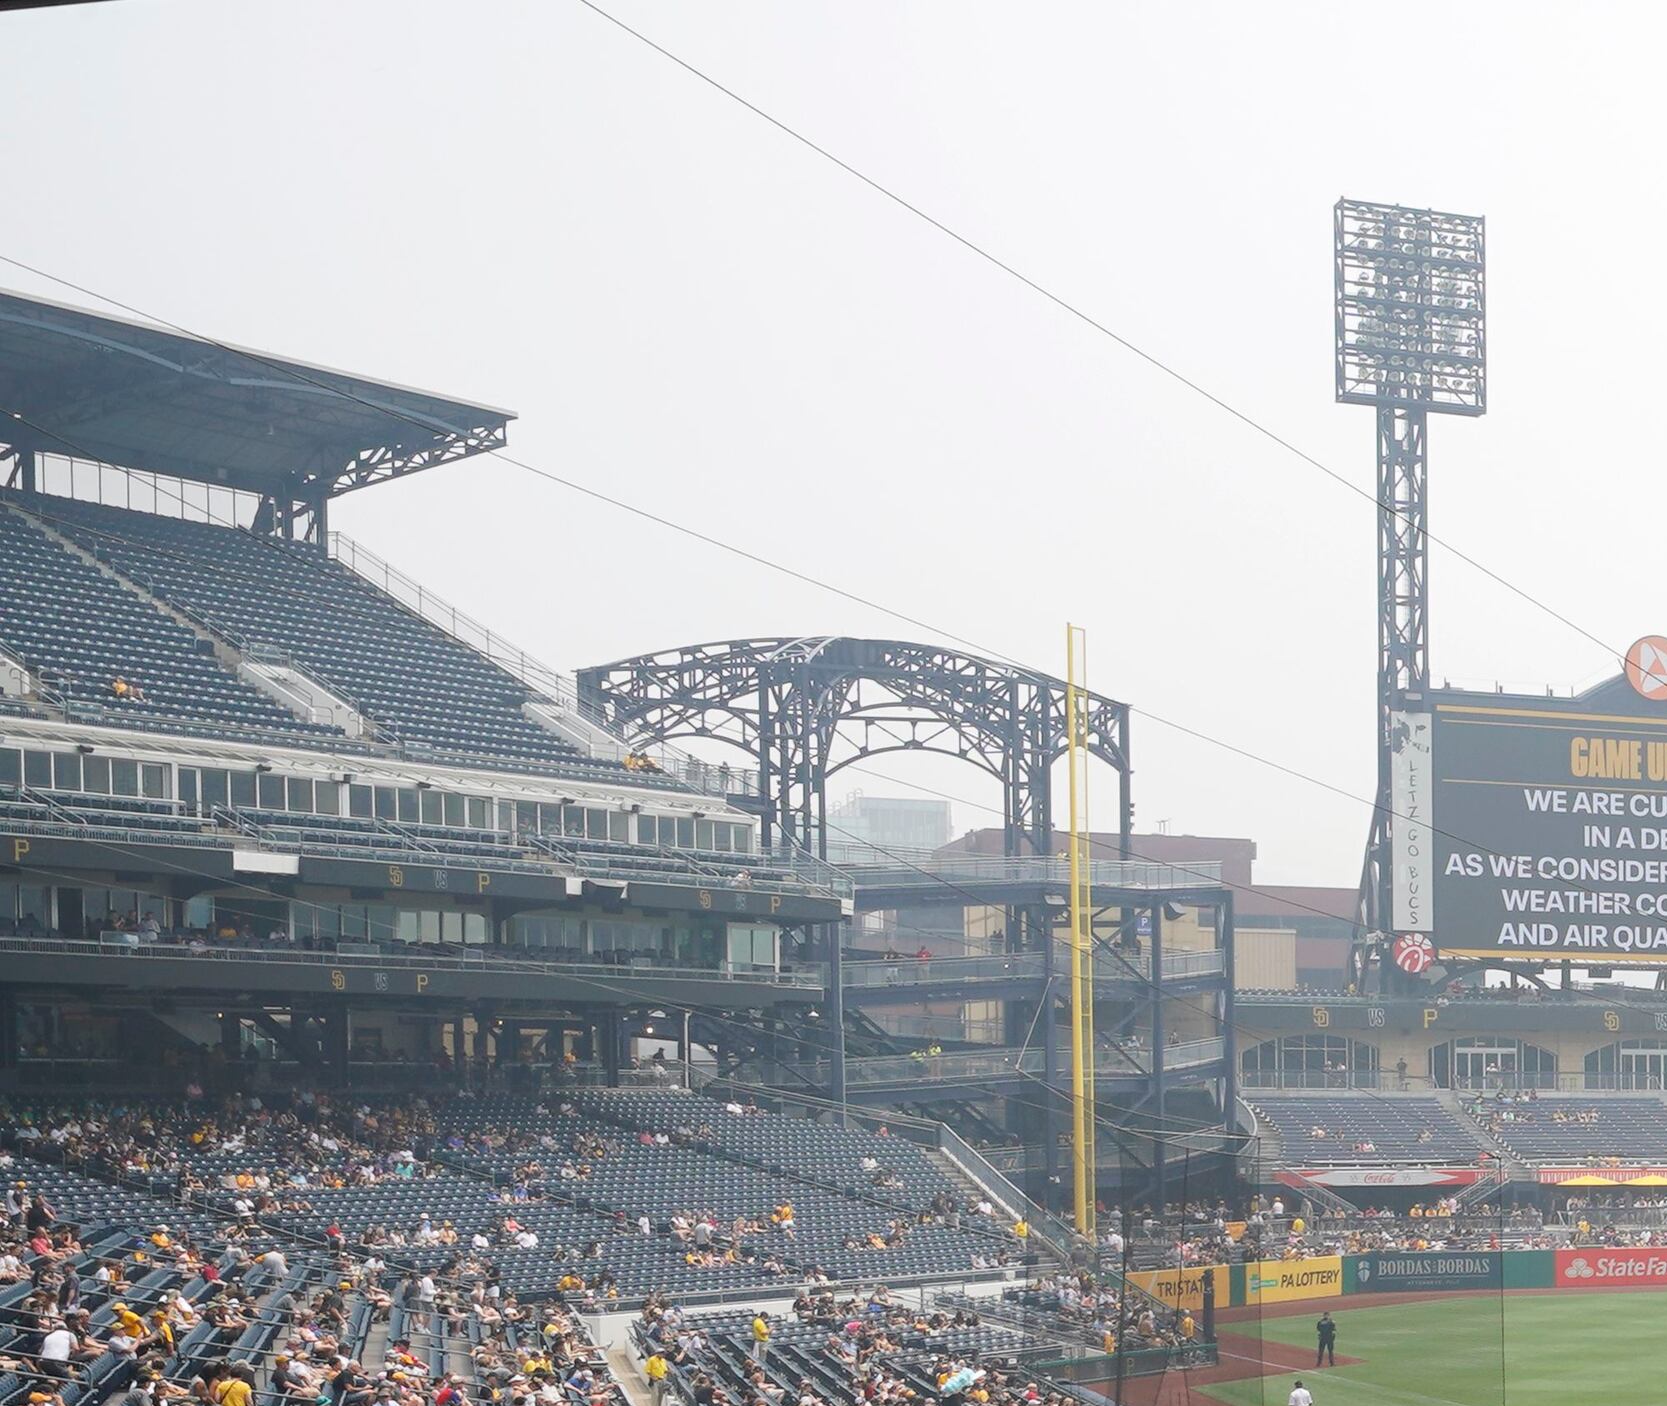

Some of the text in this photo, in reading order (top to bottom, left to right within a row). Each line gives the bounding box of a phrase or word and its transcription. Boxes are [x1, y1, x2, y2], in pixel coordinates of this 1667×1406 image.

[1570, 736, 1642, 780] GAME
[1524, 789, 1566, 814] WE
[1572, 792, 1624, 816] ARE
[1584, 826, 1611, 848] IN
[1615, 827, 1636, 849] A
[1444, 853, 1483, 877] AS
[1489, 855, 1532, 878] WE
[1502, 888, 1631, 915] WEATHER
[1498, 923, 1558, 946] AND
[1563, 924, 1608, 948] AIR
[1368, 1007, 1385, 1028] VS
[1423, 1008, 1438, 1029] P
[1281, 1273, 1296, 1289] PA
[1296, 1269, 1341, 1288] LOTTERY
[1378, 1258, 1491, 1276] BORDAS BORDAS
[1157, 1278, 1205, 1299] TRISTAT
